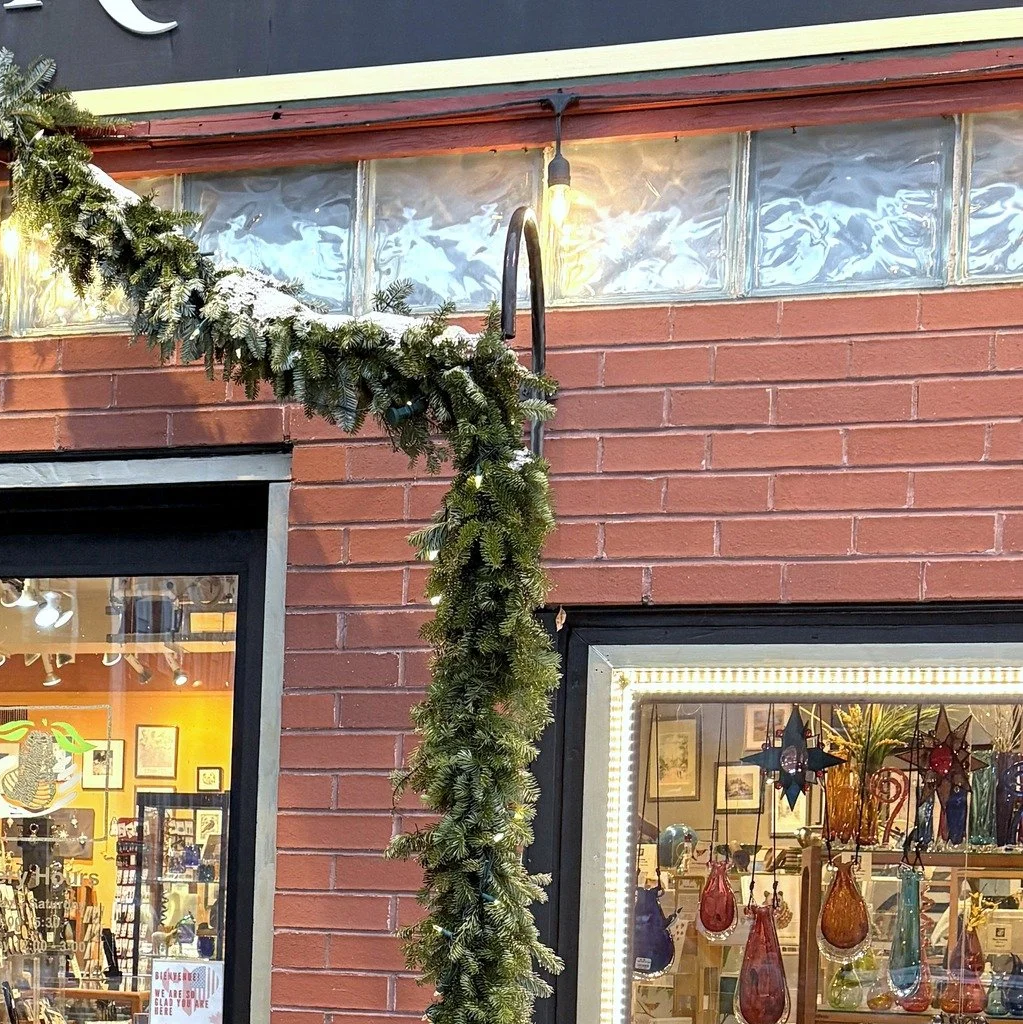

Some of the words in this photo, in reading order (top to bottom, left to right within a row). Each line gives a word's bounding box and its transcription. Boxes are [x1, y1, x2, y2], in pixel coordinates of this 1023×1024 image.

[36, 866, 100, 887] Hours
[15, 939, 47, 953] 2:00
[154, 989, 165, 998] WE
[169, 989, 182, 999] ARE
[186, 990, 195, 999] SO
[154, 998, 173, 1007] GLAD
[177, 999, 191, 1008] YOU
[194, 999, 209, 1009] ARE
[154, 1007, 173, 1016] HERE
